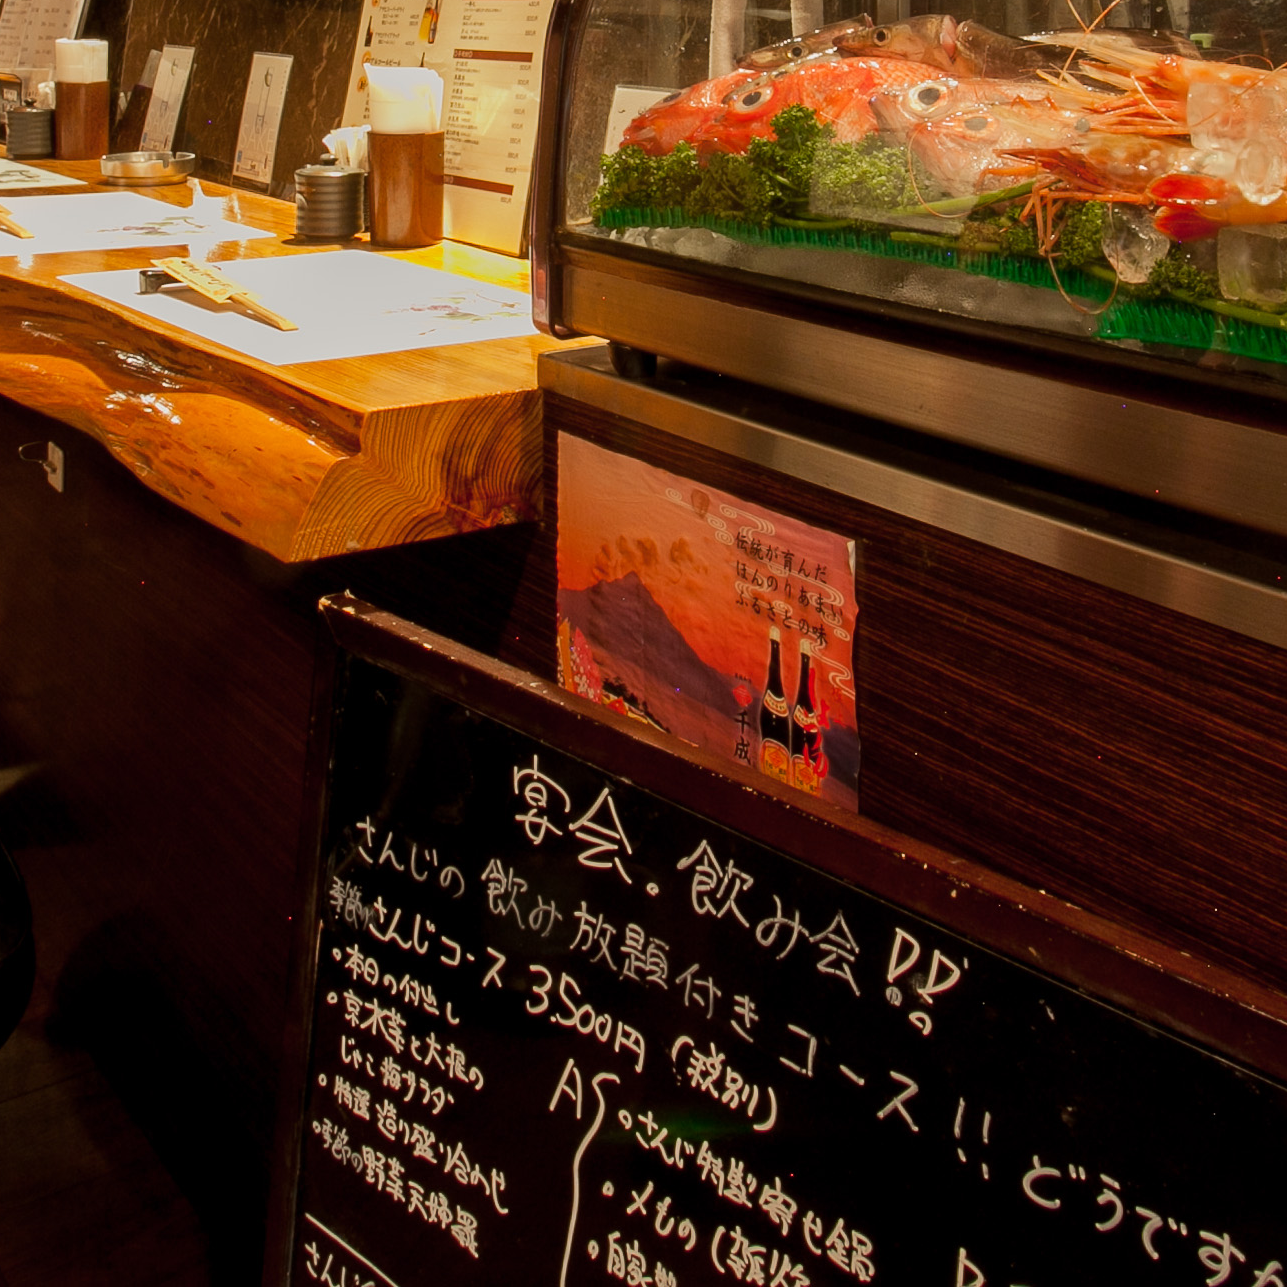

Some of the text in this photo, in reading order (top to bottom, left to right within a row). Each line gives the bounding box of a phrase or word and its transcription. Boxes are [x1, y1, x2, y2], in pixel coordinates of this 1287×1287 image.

[735, 531, 829, 585] 伝統が育んだ
[735, 561, 843, 619] ほんのりあまい
[735, 592, 829, 647] ふるさとの味
[733, 710, 752, 766] 千成
[343, 943, 461, 1026] 本日の付出し
[342, 988, 485, 1091] 京水菜と大根の
[340, 1034, 456, 1115] じゃこ梅サラダ
[549, 1058, 583, 1120] A
[671, 1036, 777, 1131] (税別)
